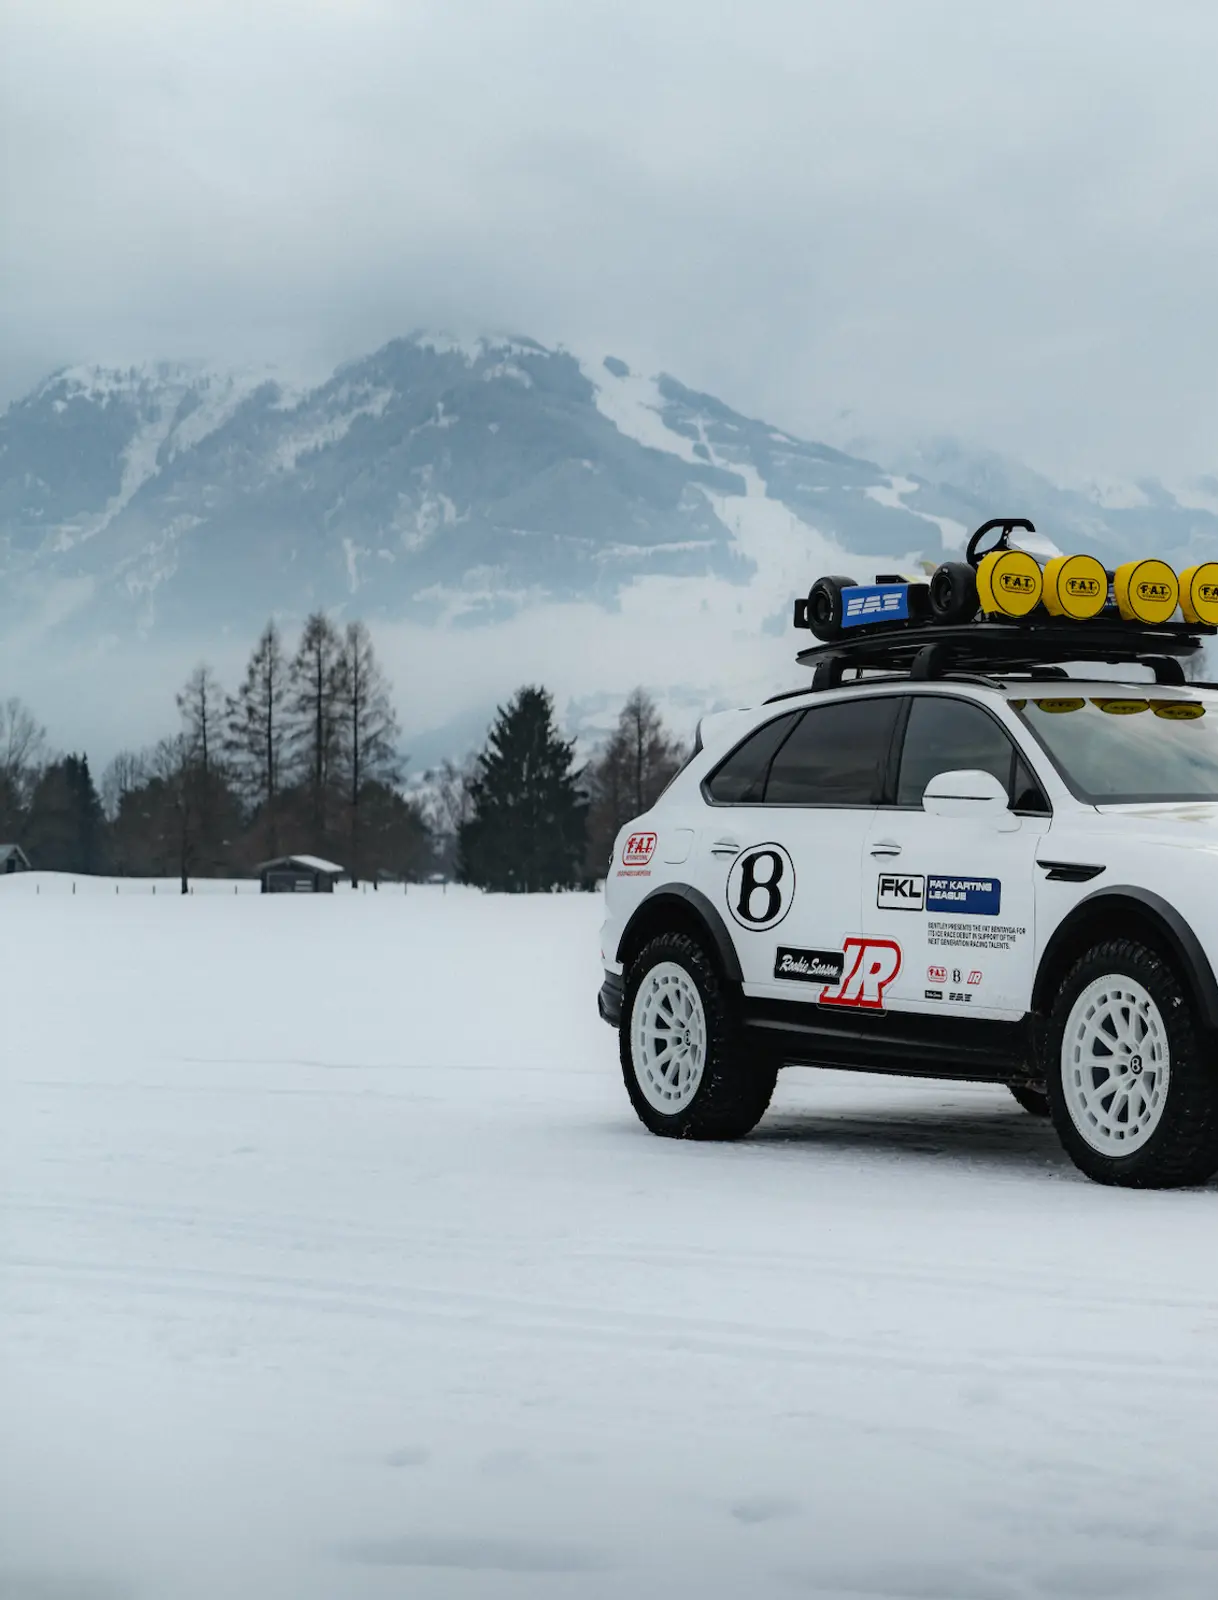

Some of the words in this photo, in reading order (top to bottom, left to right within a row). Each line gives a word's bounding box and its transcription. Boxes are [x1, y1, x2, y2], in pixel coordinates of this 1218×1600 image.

[881, 879, 922, 898] FKL
[929, 880, 948, 890] FAT
[949, 881, 993, 892] KARTING
[928, 890, 967, 901] LEAGUE
[928, 921, 947, 930] BENTLEY
[948, 923, 971, 932] PRESENTS
[972, 924, 981, 932] THE
[1016, 927, 1026, 935] FOR
[928, 937, 940, 946] NEXT
[940, 938, 969, 947] GENERATION
[970, 940, 988, 949] RACING
[944, 931, 956, 939] RACE
[956, 931, 971, 940] DEBUT
[978, 933, 999, 941] SUPPORT
[1006, 934, 1016, 943] THE
[779, 954, 808, 973] Rookie
[806, 957, 839, 977] Season
